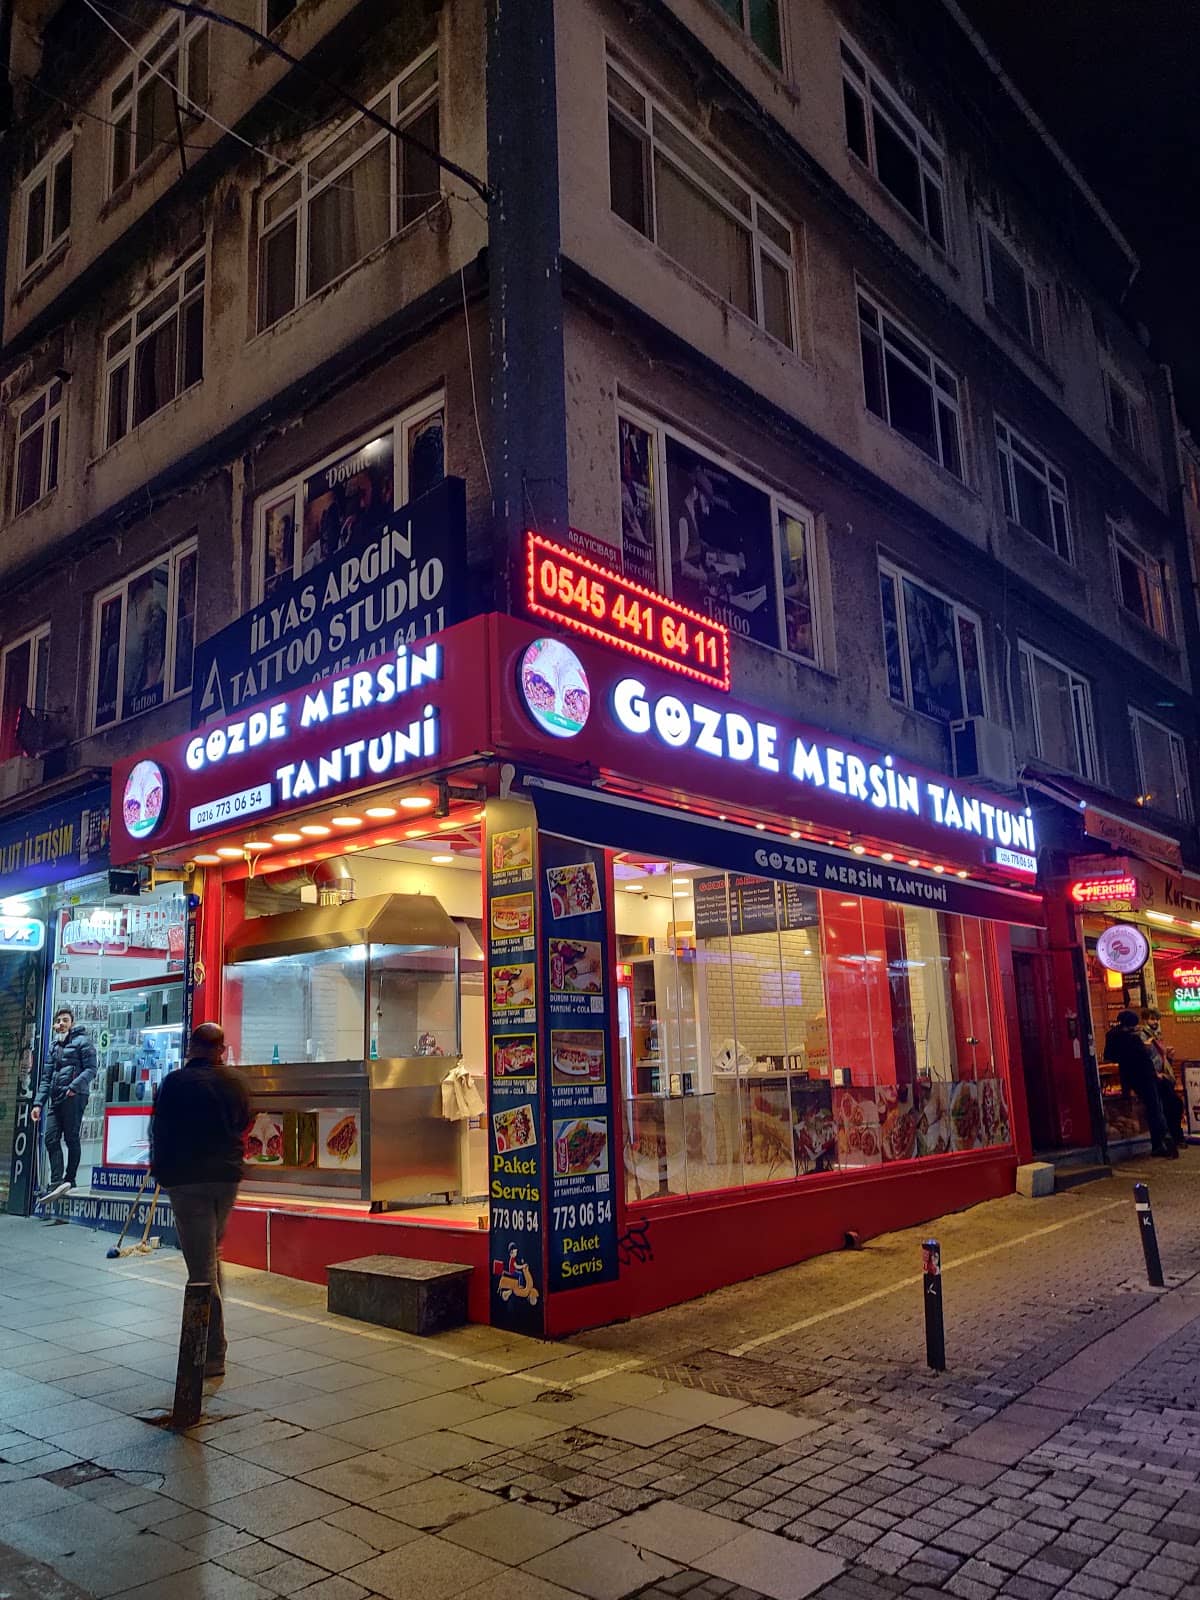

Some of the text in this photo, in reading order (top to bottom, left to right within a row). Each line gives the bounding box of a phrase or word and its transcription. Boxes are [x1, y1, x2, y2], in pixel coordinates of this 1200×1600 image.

[251, 520, 412, 655] İLYAS ARGİN
[540, 560, 718, 668] 0545 441 64 11
[703, 596, 750, 635] Tattoo
[230, 557, 444, 706] TATTOO STUDİO
[393, 624, 417, 648] 64
[301, 642, 440, 728] MERSİN
[130, 692, 157, 713] Tattoo
[276, 705, 437, 800] TANTUNİ
[197, 790, 263, 824] 0216 773 06 54
[791, 738, 920, 815] MERSİN
[928, 781, 1036, 851] TANTUNİ
[0, 819, 74, 874] LUT İLETİŞİM
[825, 863, 883, 889] MERSİN
[888, 876, 947, 902] TANTUNİ
[1087, 883, 1133, 896] PIERCING
[577, 1005, 590, 1014] COLA
[493, 1155, 537, 1175] Paket
[100, 1172, 107, 1185] EL
[109, 1173, 135, 1187] TELEFON
[491, 1180, 540, 1202] Servis
[58, 1199, 97, 1219] TELEFON
[99, 1200, 129, 1221] ALINIR
[493, 1208, 538, 1232] 773 06 54
[553, 1200, 611, 1231] 773 06 54
[562, 1235, 600, 1255] Paket
[561, 1257, 603, 1278] Servis
